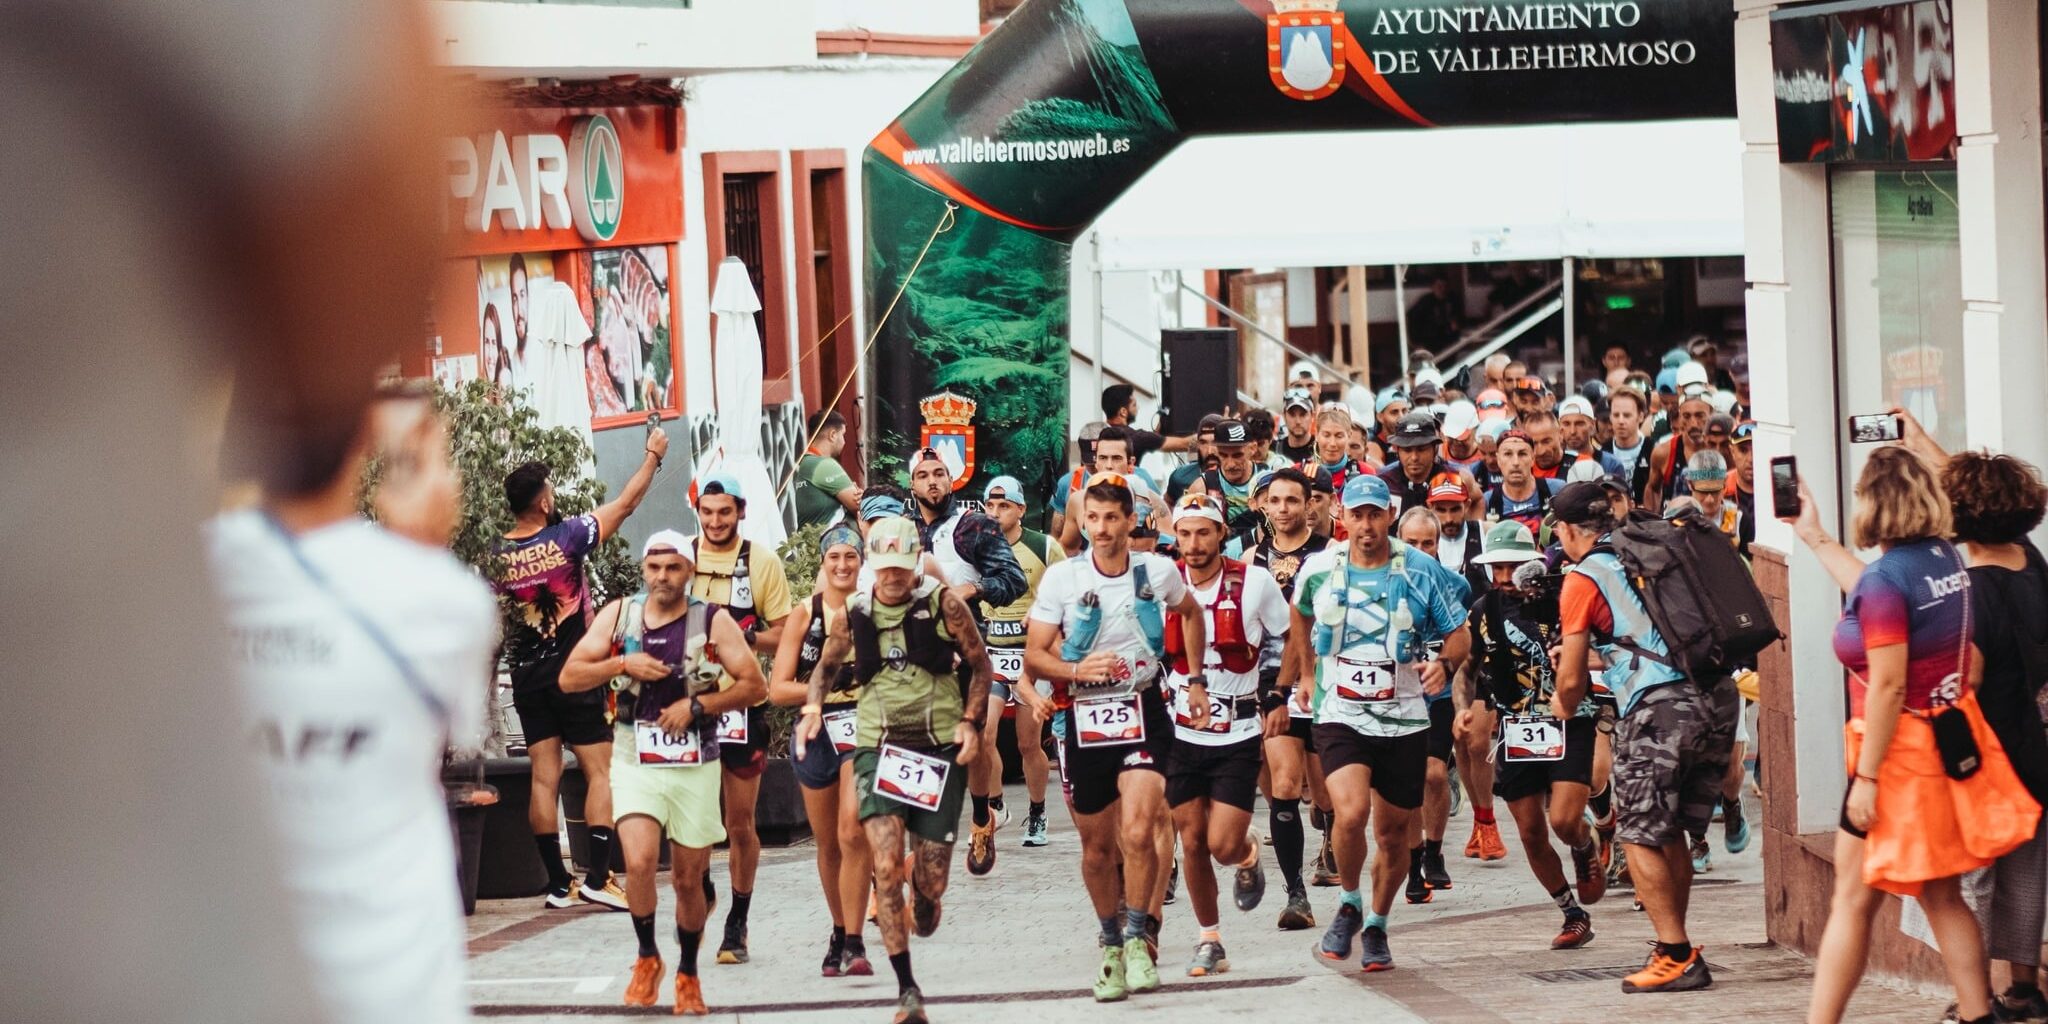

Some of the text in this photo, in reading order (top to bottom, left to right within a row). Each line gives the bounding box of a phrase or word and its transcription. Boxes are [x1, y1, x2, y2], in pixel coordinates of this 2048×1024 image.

[1371, 1, 1640, 35] AYUNTAMIENTO
[1372, 40, 1696, 74] DE VALLEHERMOSO
[902, 133, 1130, 165] www.vallehermosoweb.es
[445, 129, 572, 233] PAR
[501, 540, 561, 566] OMERA
[502, 551, 568, 583] ARADISE
[1000, 658, 1021, 671] 20
[1351, 670, 1376, 685] 41
[1088, 707, 1129, 725] 125
[1210, 702, 1223, 717] 2
[649, 731, 689, 747] 108
[842, 722, 855, 737] 3
[1522, 727, 1545, 742] 31
[898, 764, 924, 785] 51
